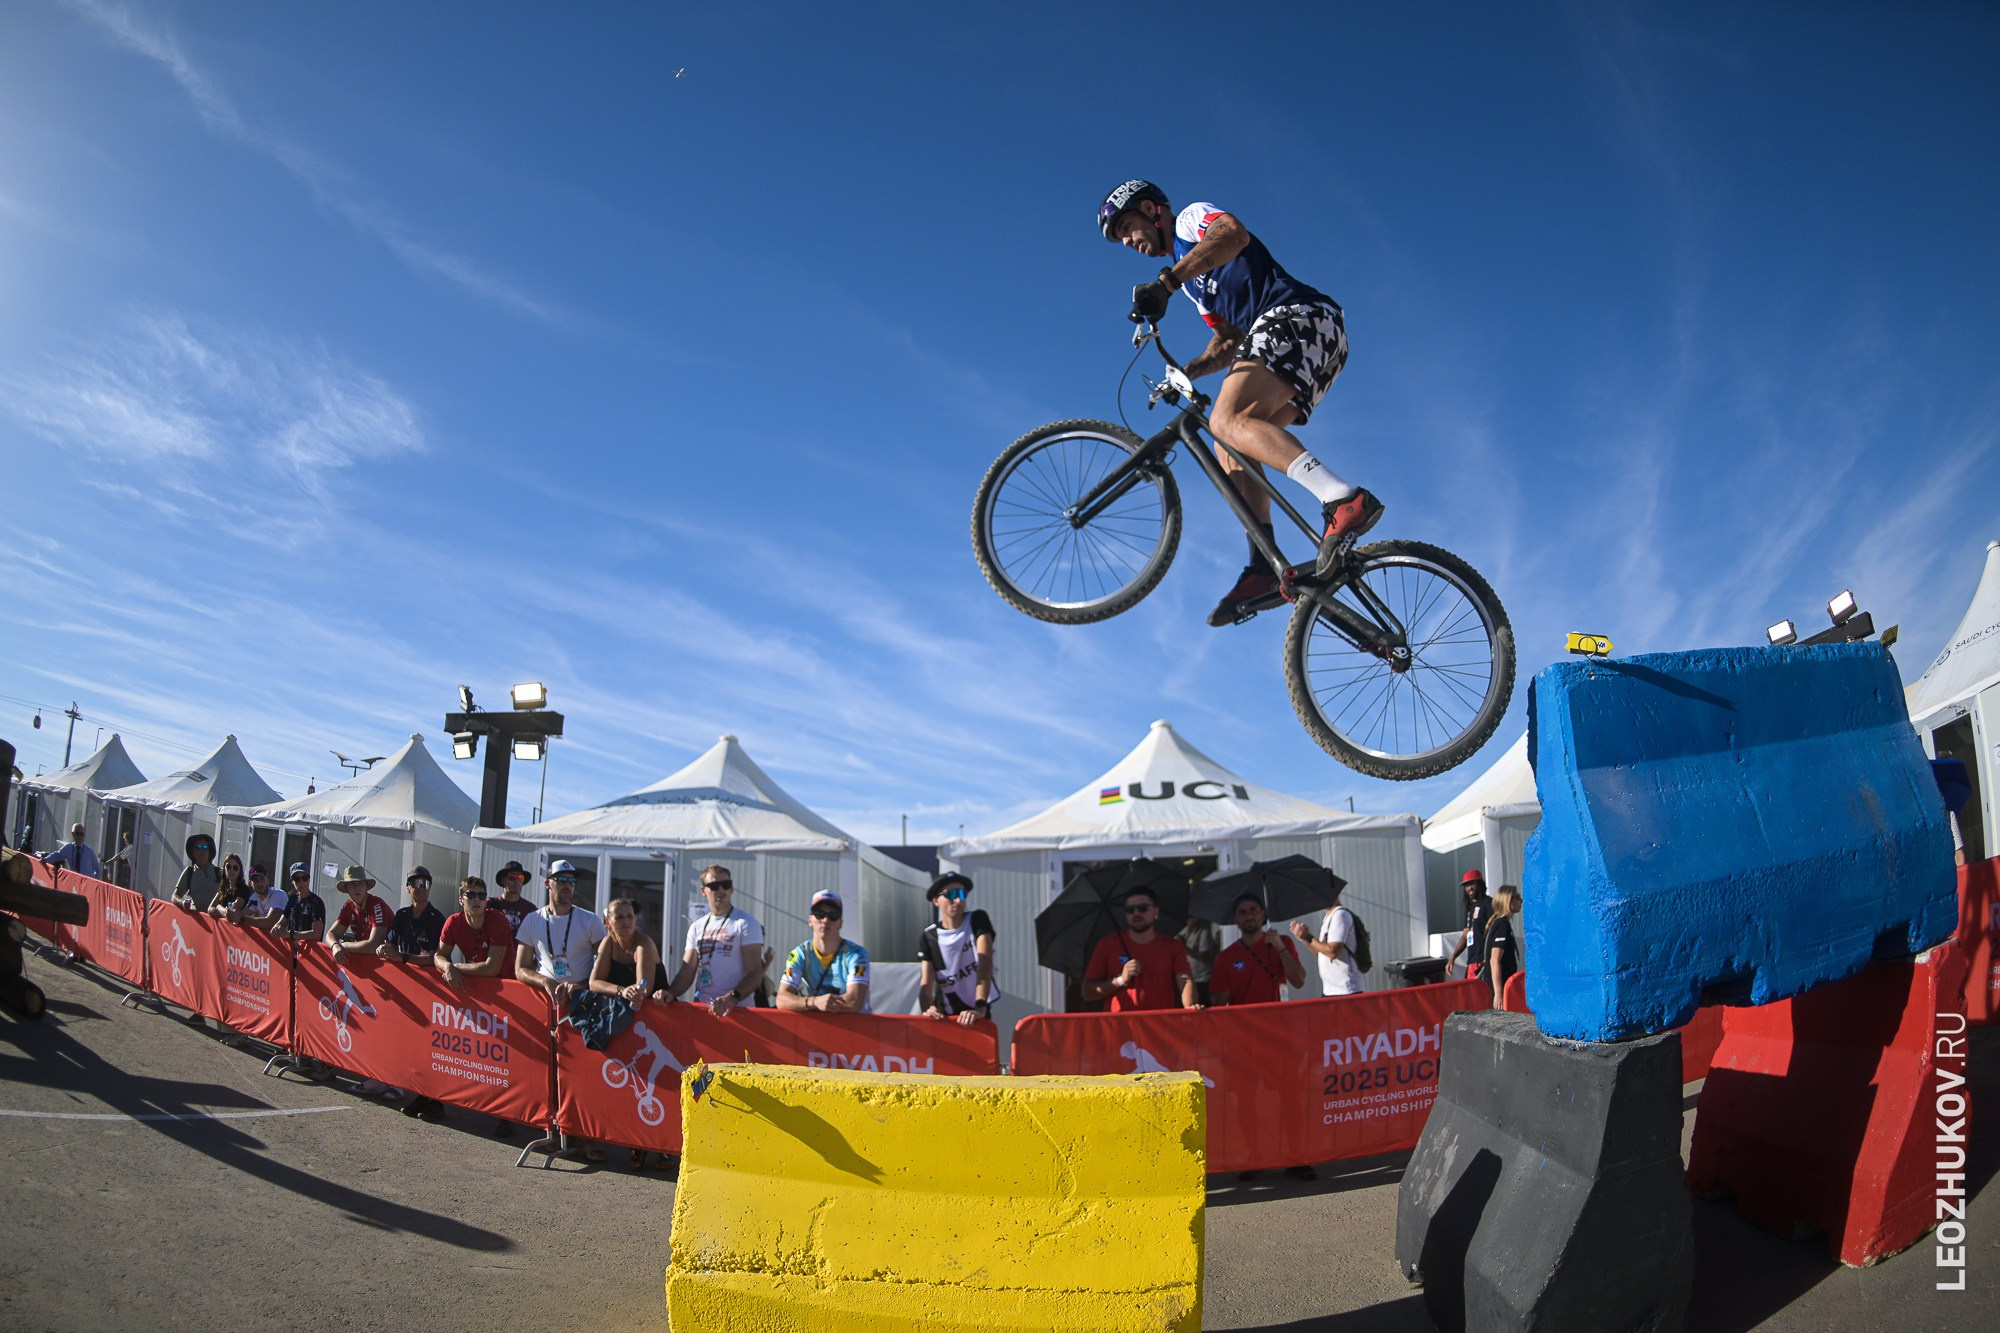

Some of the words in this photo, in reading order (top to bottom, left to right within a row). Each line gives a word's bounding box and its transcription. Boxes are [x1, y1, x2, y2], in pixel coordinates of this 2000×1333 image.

[1114, 181, 1149, 209] BIKES
[1303, 457, 1320, 472] 23
[1955, 630, 1982, 650] SAUDI
[1129, 781, 1249, 800] UCI
[106, 906, 131, 929] RIYADH
[227, 945, 270, 976] RIYADH
[227, 968, 250, 989] 2025
[251, 977, 270, 995] UCI
[227, 994, 270, 1016] CHAMPIONSHIPS
[432, 1001, 508, 1039] RIYADH
[431, 1030, 472, 1055] 2025
[476, 1040, 509, 1064] UCI
[1323, 1023, 1440, 1067] RIYADH
[431, 1051, 454, 1063] URBAN
[454, 1057, 482, 1070] CYCLING
[483, 1064, 509, 1076] WORLD
[431, 1062, 509, 1088] CHAMPIONSHIPS
[1323, 1067, 1389, 1095] 2025
[1396, 1057, 1441, 1084] UCI
[1323, 1098, 1359, 1110] URBAN
[1361, 1090, 1405, 1105] CYCLING
[1323, 1098, 1437, 1125] CHAMPIONSHIP
